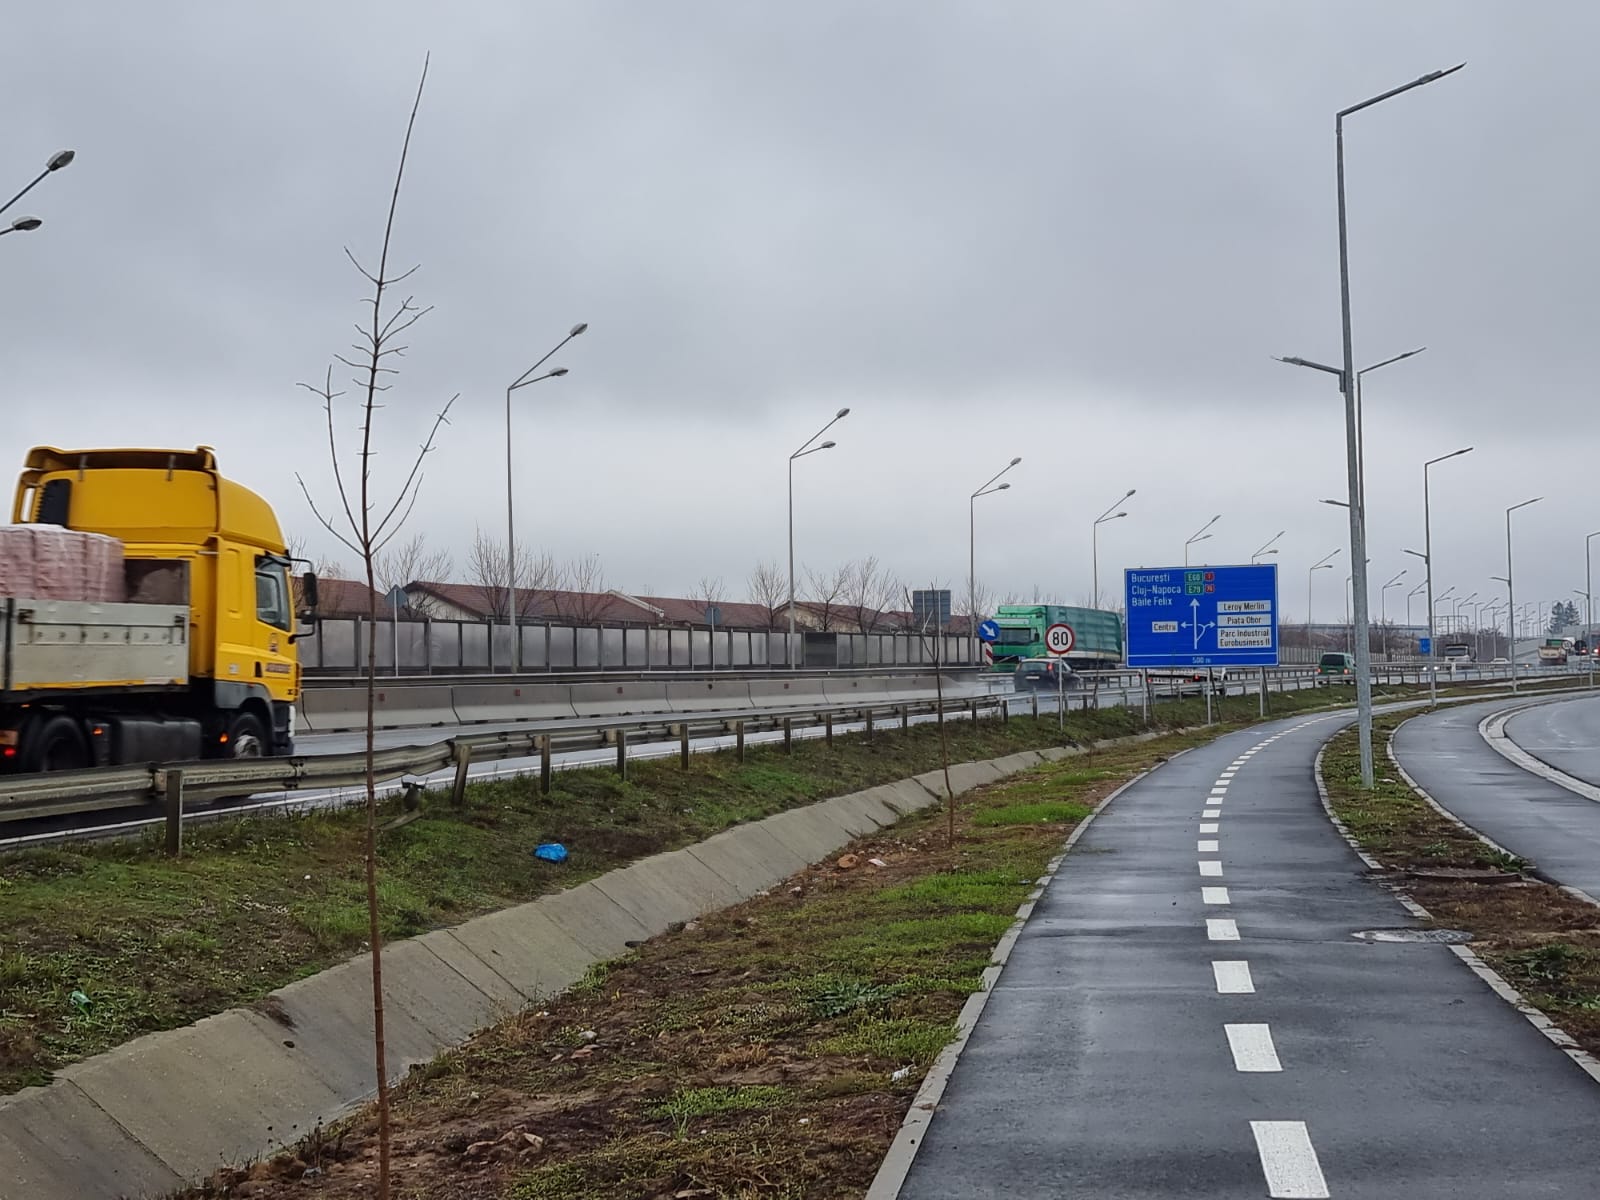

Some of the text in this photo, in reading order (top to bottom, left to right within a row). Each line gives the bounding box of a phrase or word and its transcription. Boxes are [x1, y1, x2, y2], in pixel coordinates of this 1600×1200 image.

[1188, 573, 1200, 581] E60
[1131, 584, 1182, 597] Cluj-Napoca
[1153, 596, 1173, 606] Felix
[1223, 602, 1265, 612] Leroy Merlin
[1246, 615, 1261, 624] Obor
[1153, 623, 1176, 631] Centru
[1220, 628, 1269, 637] Parc Industrial
[1052, 631, 1069, 646] 80
[1220, 638, 1264, 647] Eurobusiness
